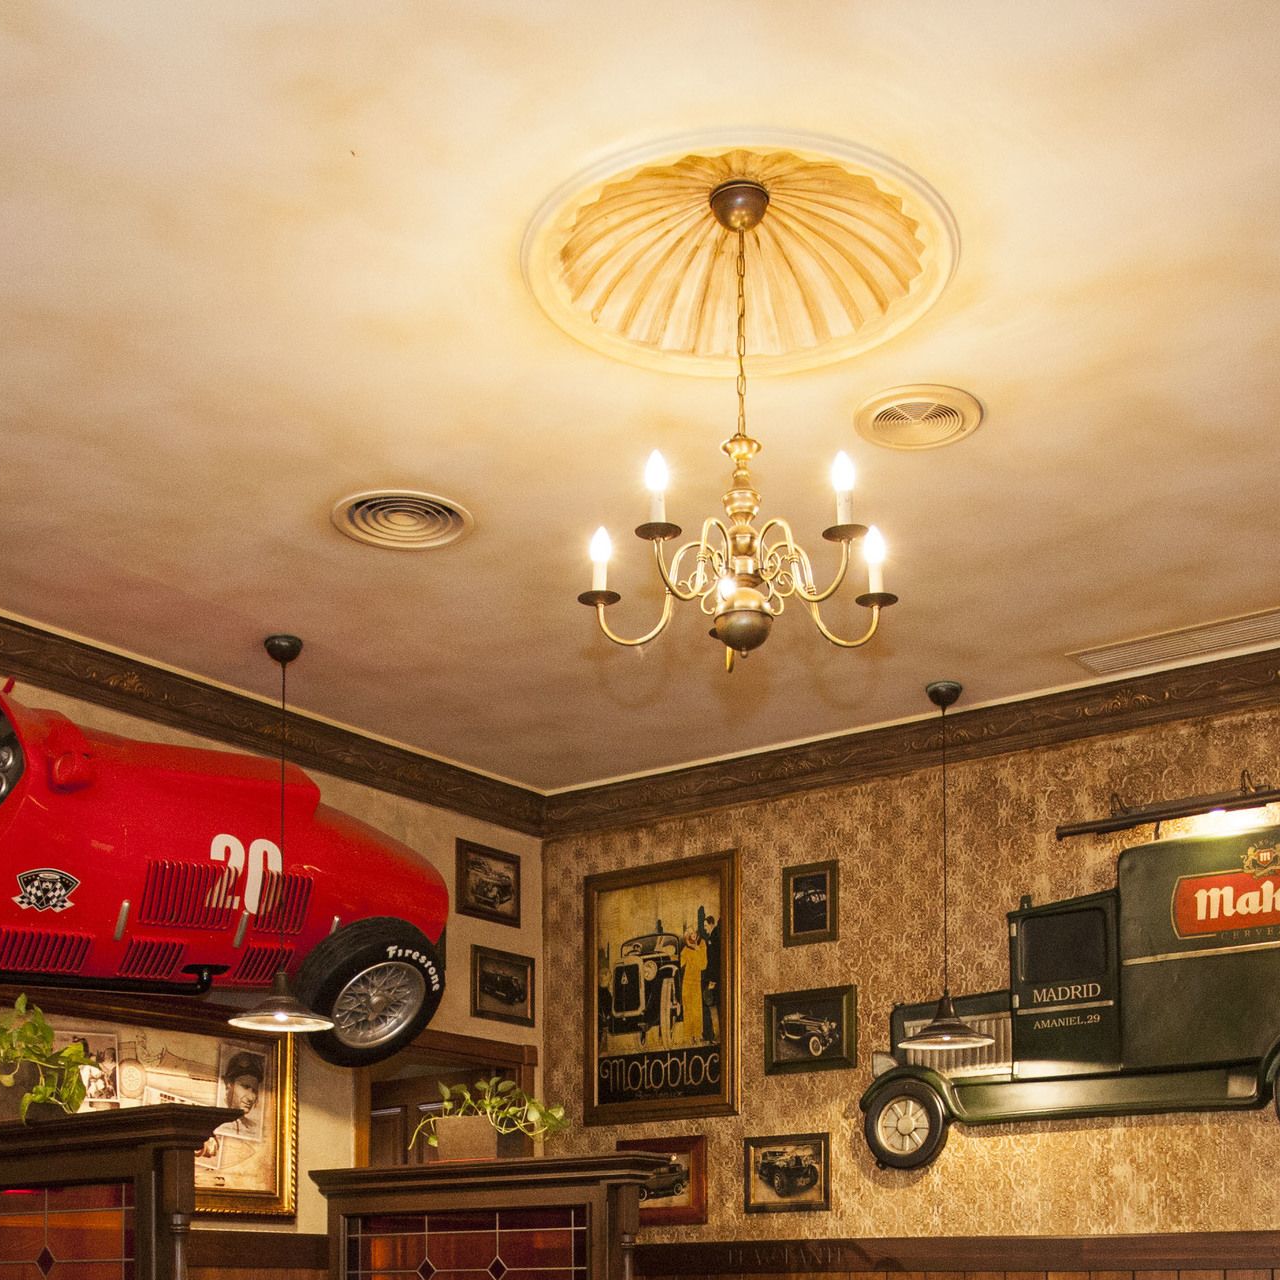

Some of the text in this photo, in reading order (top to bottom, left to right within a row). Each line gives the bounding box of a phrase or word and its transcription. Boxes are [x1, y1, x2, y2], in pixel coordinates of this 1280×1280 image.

[205, 833, 282, 915] 20
[386, 945, 440, 992] Firestone
[1033, 983, 1101, 1003] MADRID
